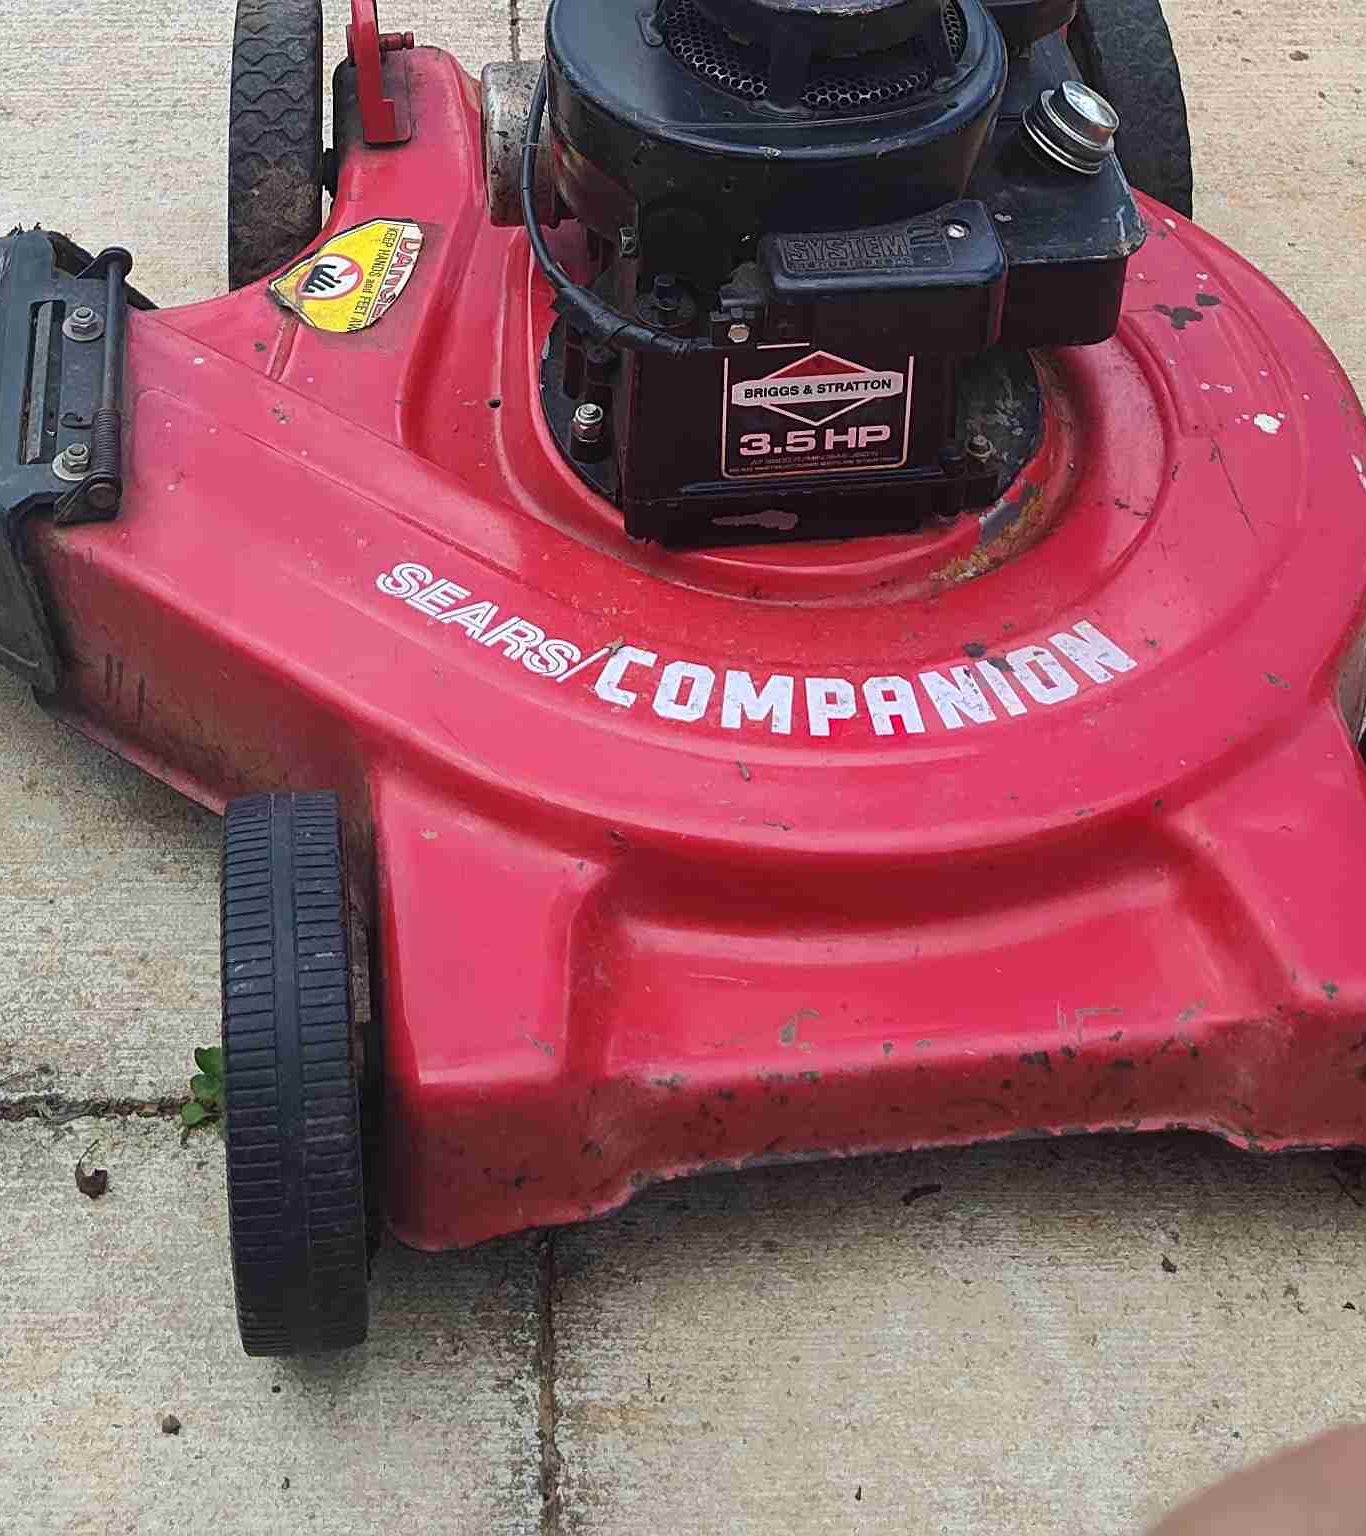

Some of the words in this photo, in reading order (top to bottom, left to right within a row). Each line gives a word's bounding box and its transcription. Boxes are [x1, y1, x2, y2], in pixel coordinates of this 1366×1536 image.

[786, 234, 909, 261] SYSTEM
[368, 249, 392, 278] HANDS
[352, 294, 373, 315] FEET
[744, 384, 799, 399] BRIGGS
[802, 384, 813, 395] &
[816, 378, 892, 394] STRATTON
[739, 429, 816, 456] 3.5
[824, 424, 891, 450] HP
